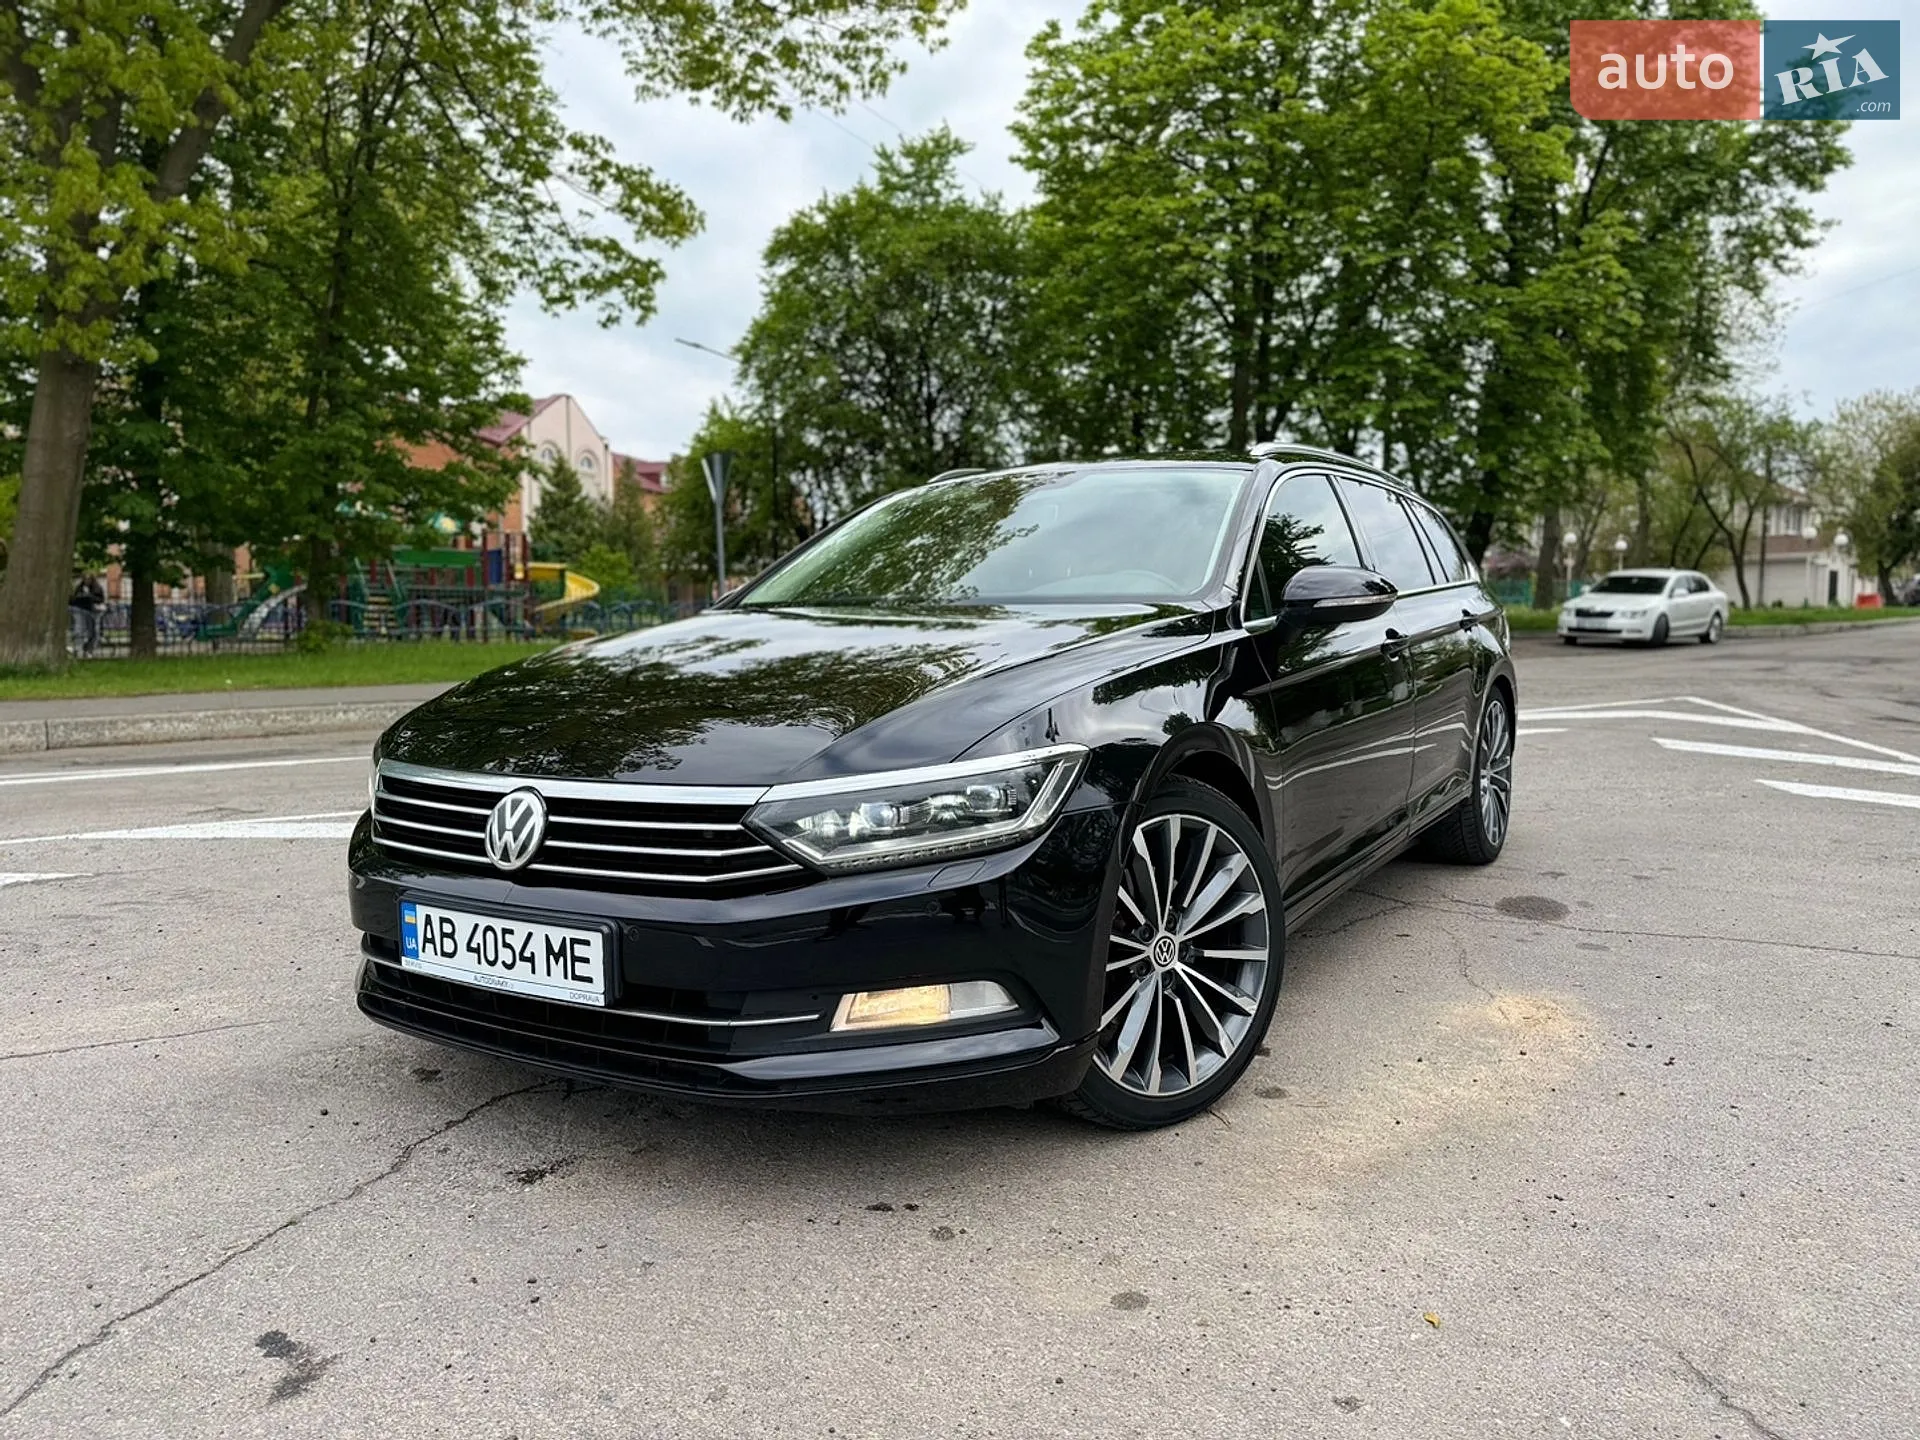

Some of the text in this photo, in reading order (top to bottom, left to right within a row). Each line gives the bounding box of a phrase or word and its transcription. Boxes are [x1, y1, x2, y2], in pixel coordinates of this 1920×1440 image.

[405, 935, 417, 951] UA
[422, 914, 594, 984] AB 4054 ME
